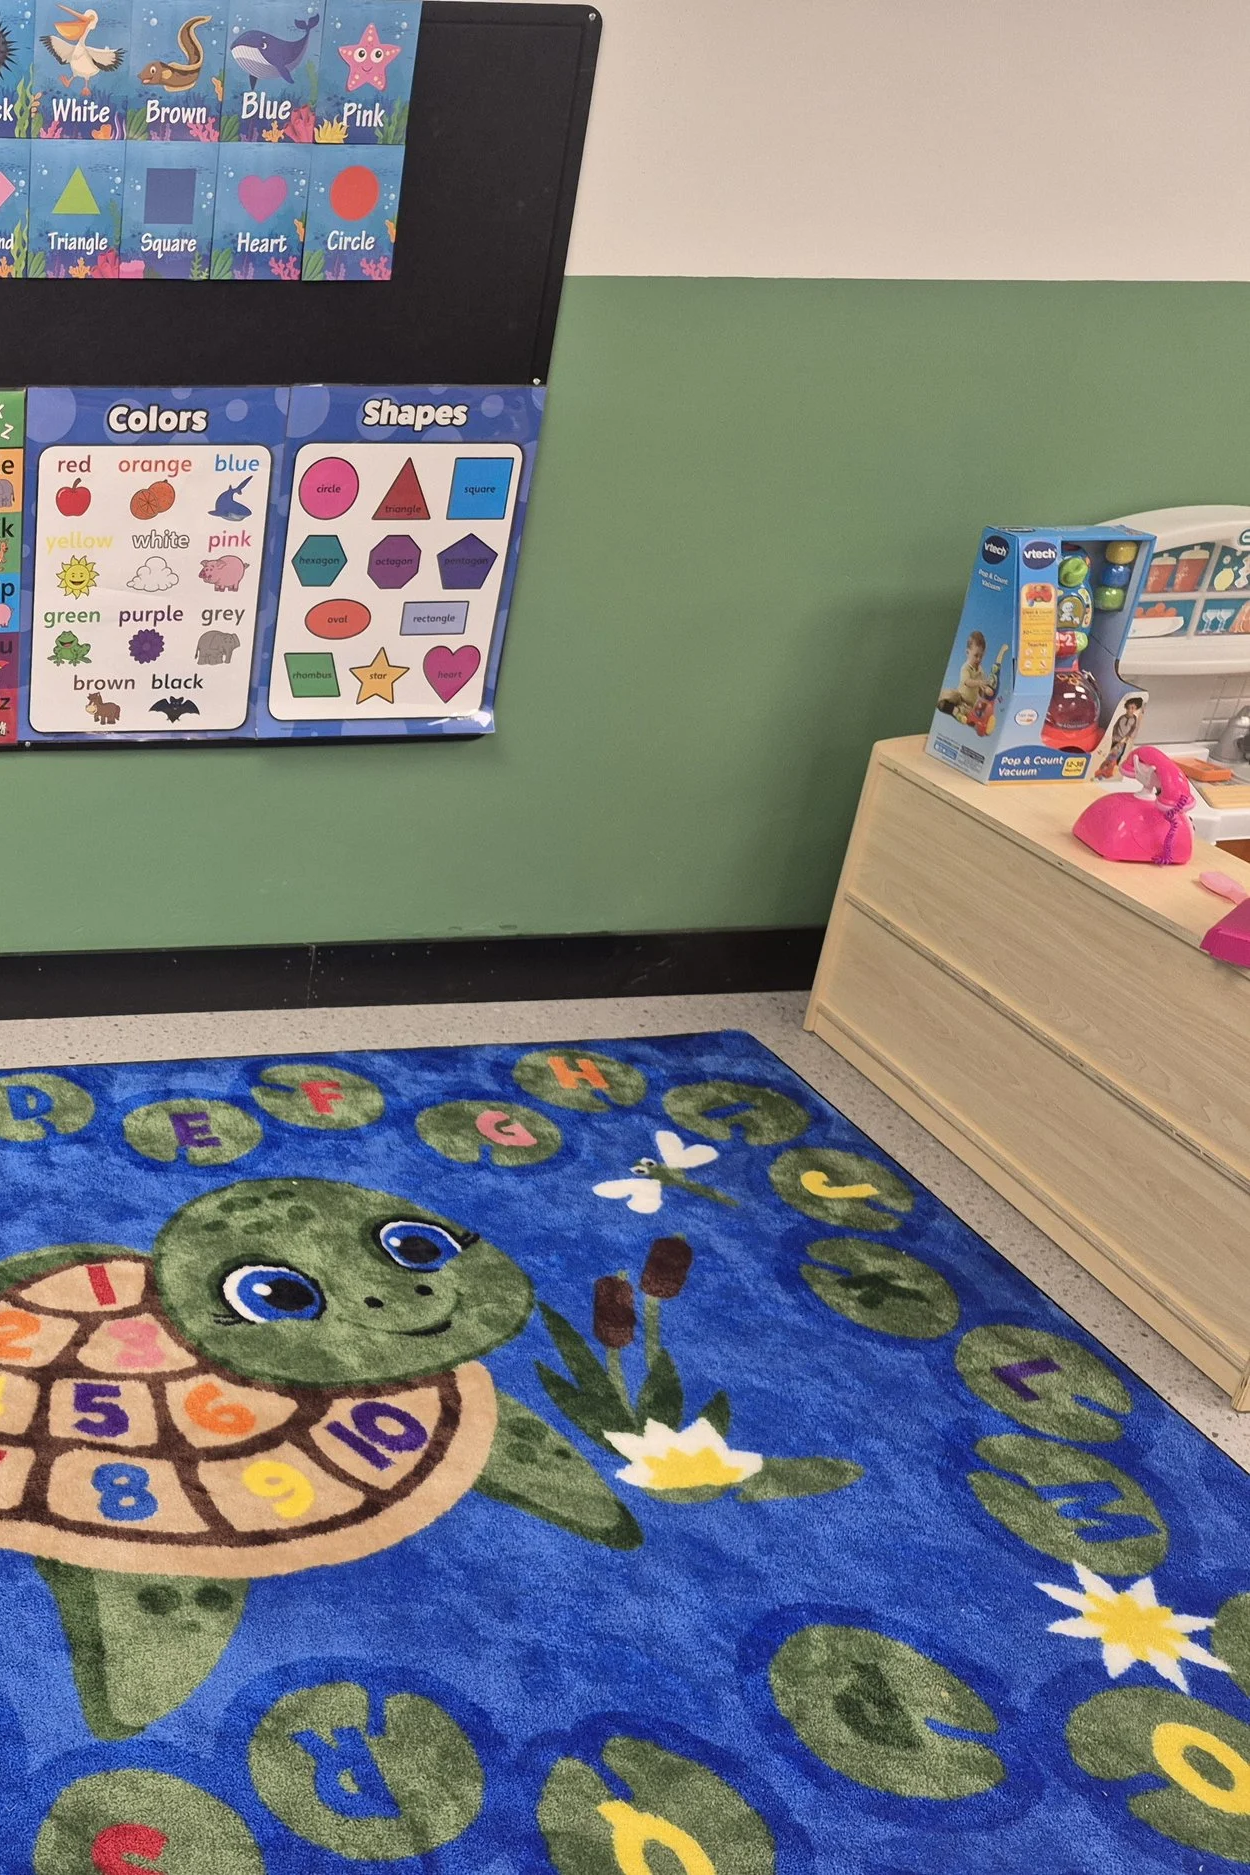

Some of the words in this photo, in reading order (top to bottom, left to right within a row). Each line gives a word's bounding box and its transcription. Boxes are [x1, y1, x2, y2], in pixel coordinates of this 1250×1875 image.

[52, 98, 111, 123] White
[146, 100, 207, 124] Brown
[241, 92, 291, 120] Blue
[343, 103, 385, 128] Pink
[48, 232, 108, 255] Triangle
[141, 233, 197, 258] Square
[237, 232, 287, 253] Heart
[327, 230, 375, 251] Circle
[107, 404, 208, 433] Colors
[362, 398, 468, 432] Shapes
[0, 424, 15, 440] Z
[57, 455, 91, 473] red
[118, 457, 192, 477] orange
[214, 454, 259, 472] blue
[316, 484, 341, 494] circle
[464, 486, 496, 496] square
[385, 504, 422, 515] triangle
[46, 532, 113, 553] yellow
[132, 529, 190, 549] white
[208, 530, 252, 552] pink
[984, 542, 1007, 557] vtech
[300, 556, 340, 567] hexagon
[375, 557, 413, 568] octagon
[444, 557, 489, 567] pentagon
[1024, 548, 1056, 559] vtech
[44, 610, 101, 628] green
[119, 605, 184, 627] purple
[202, 608, 245, 625] grey
[327, 615, 348, 624] oval
[413, 614, 456, 625] rectangle
[74, 675, 135, 691] brown
[152, 674, 203, 690] black
[292, 670, 332, 680] rhombus
[369, 671, 387, 680] star
[438, 670, 462, 679] heart
[998, 768, 1037, 776] Vacuum
[1001, 756, 1021, 766] Pop
[1023, 756, 1030, 765] &
[1034, 756, 1063, 765] Count
[548, 1055, 610, 1090] H
[6, 1085, 51, 1121] D
[300, 1080, 345, 1115] F
[169, 1112, 221, 1149] E
[475, 1111, 537, 1146] G
[87, 1265, 116, 1306] 1
[106, 1318, 165, 1369] 3
[991, 1357, 1062, 1401] L
[71, 1382, 130, 1438] 5
[183, 1382, 257, 1436] 6
[326, 1402, 428, 1470] 10
[90, 1462, 158, 1522] 8
[240, 1460, 314, 1518] 9
[290, 1727, 400, 1819] R
